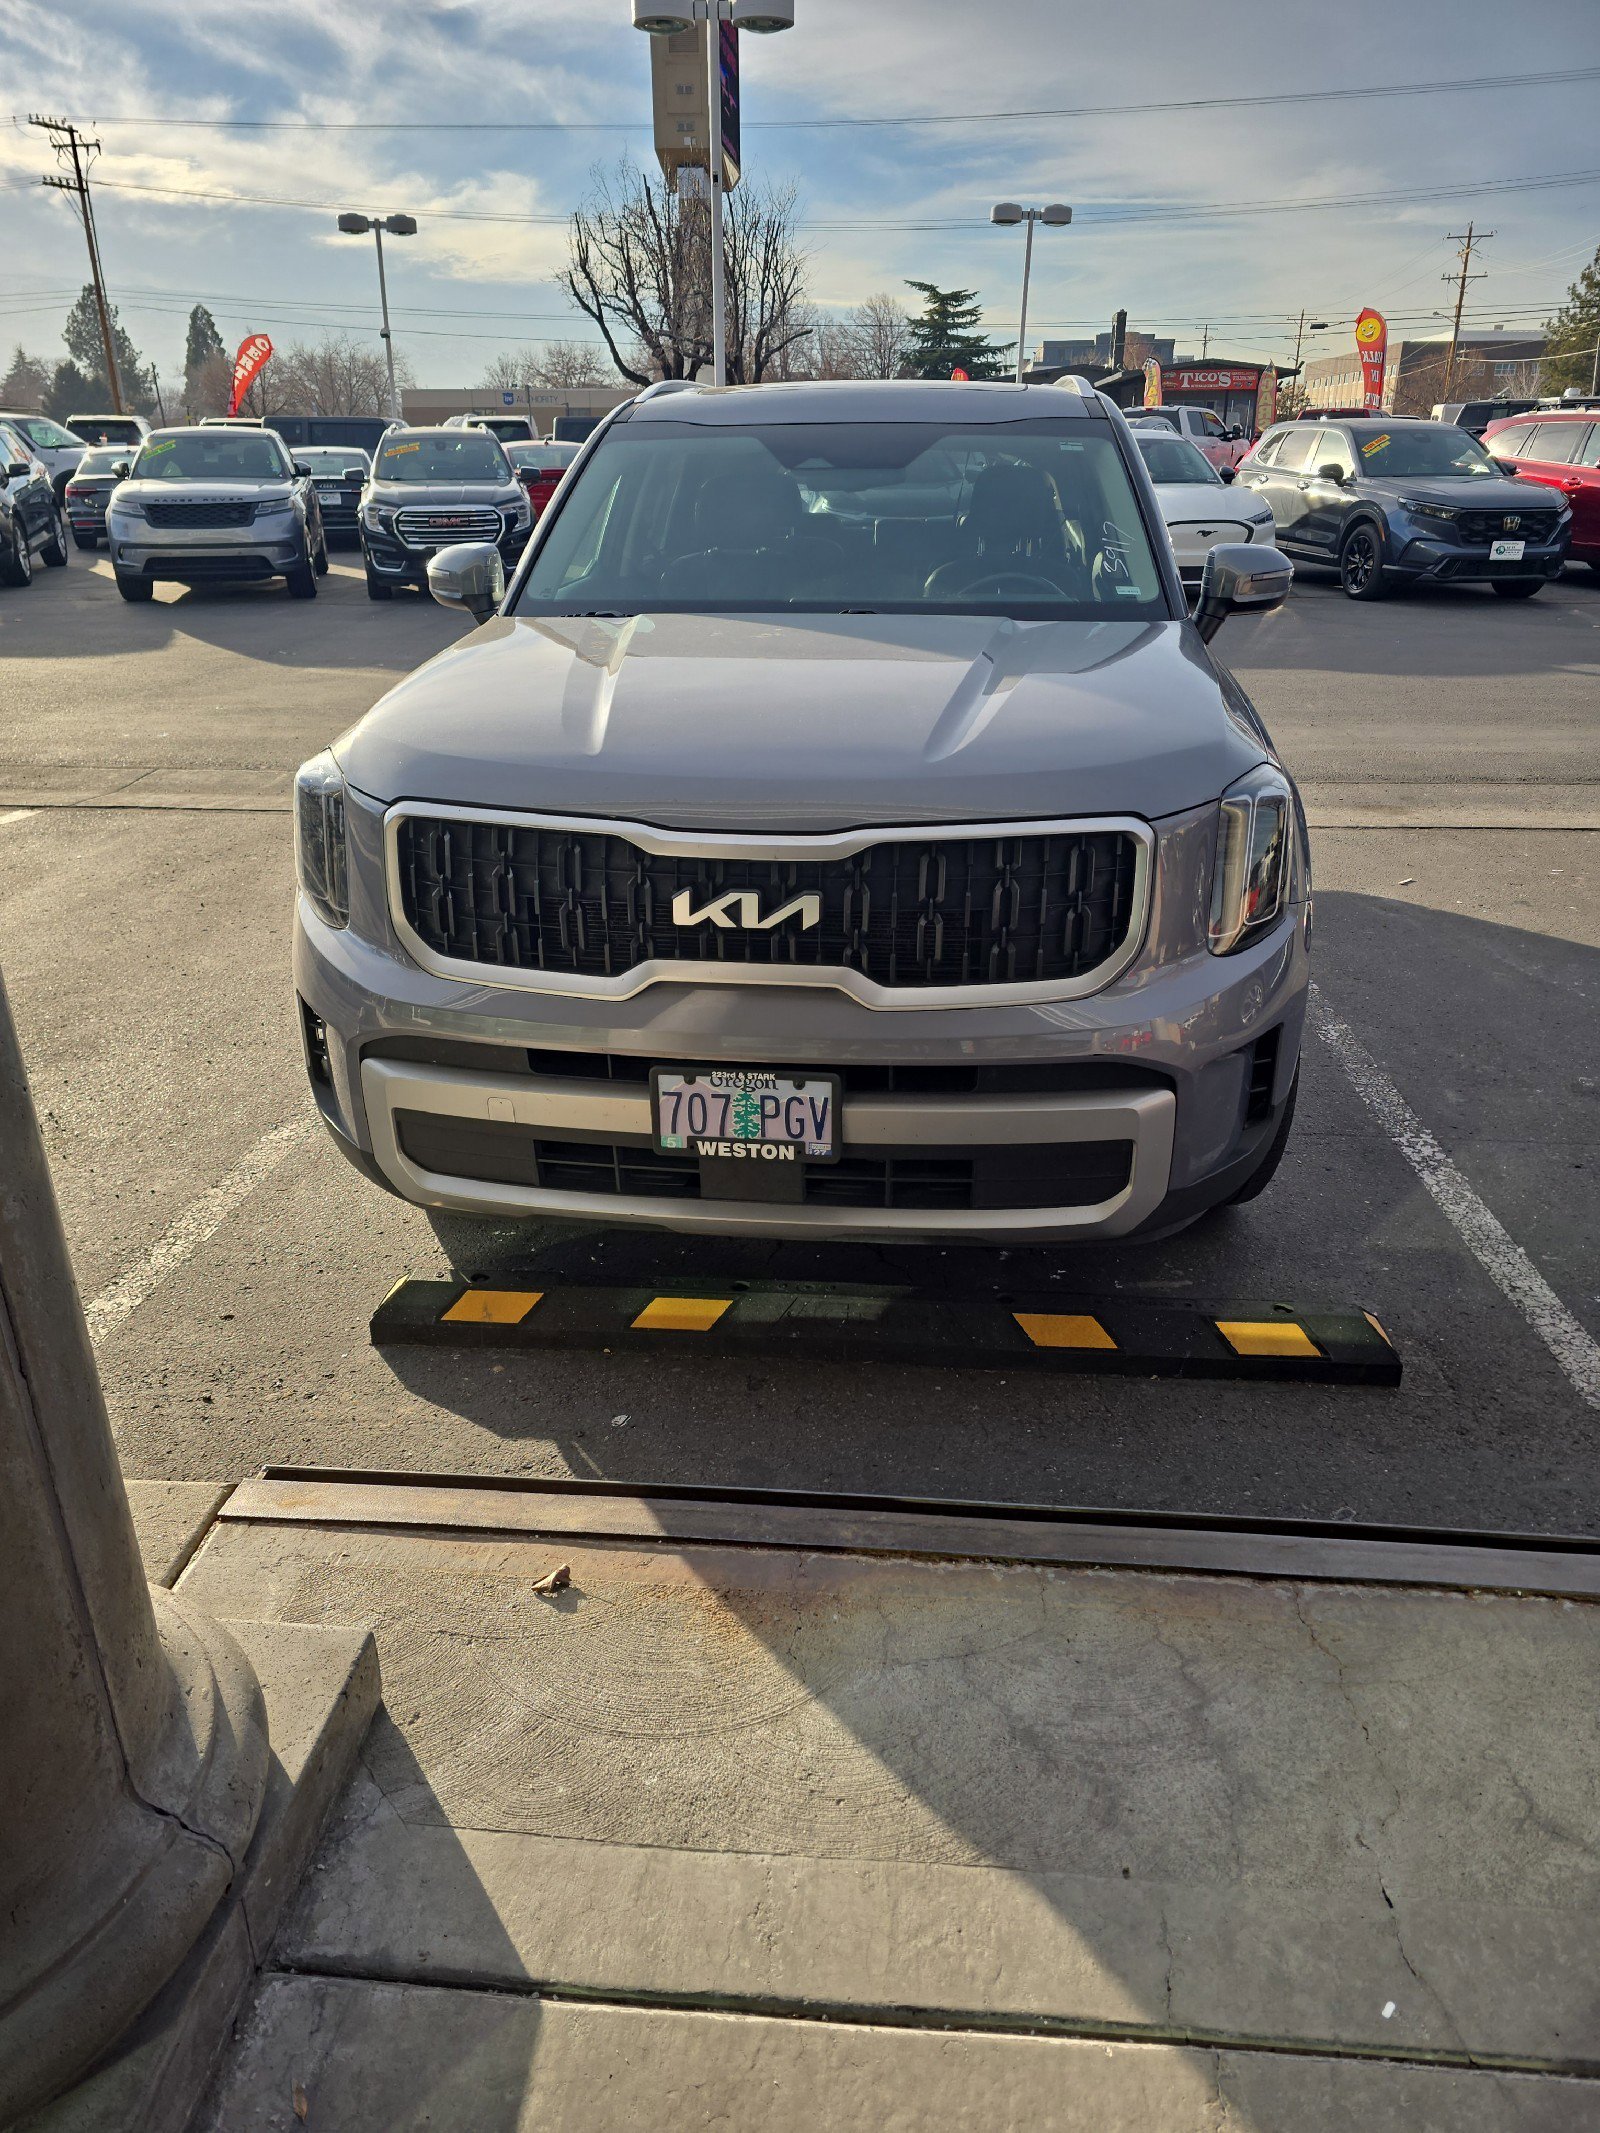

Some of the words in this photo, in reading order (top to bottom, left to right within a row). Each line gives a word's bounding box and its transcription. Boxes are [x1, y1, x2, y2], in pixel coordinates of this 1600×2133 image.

[1180, 372, 1231, 388] TICO'S
[429, 517, 470, 527] GMC
[672, 890, 820, 931] KIA
[710, 1076, 779, 1093] Oregon
[711, 1071, 736, 1079] 223rd
[747, 1072, 776, 1081] STARK
[662, 1091, 731, 1137] 707
[760, 1095, 829, 1141] PGV
[696, 1141, 795, 1160] WESTON
